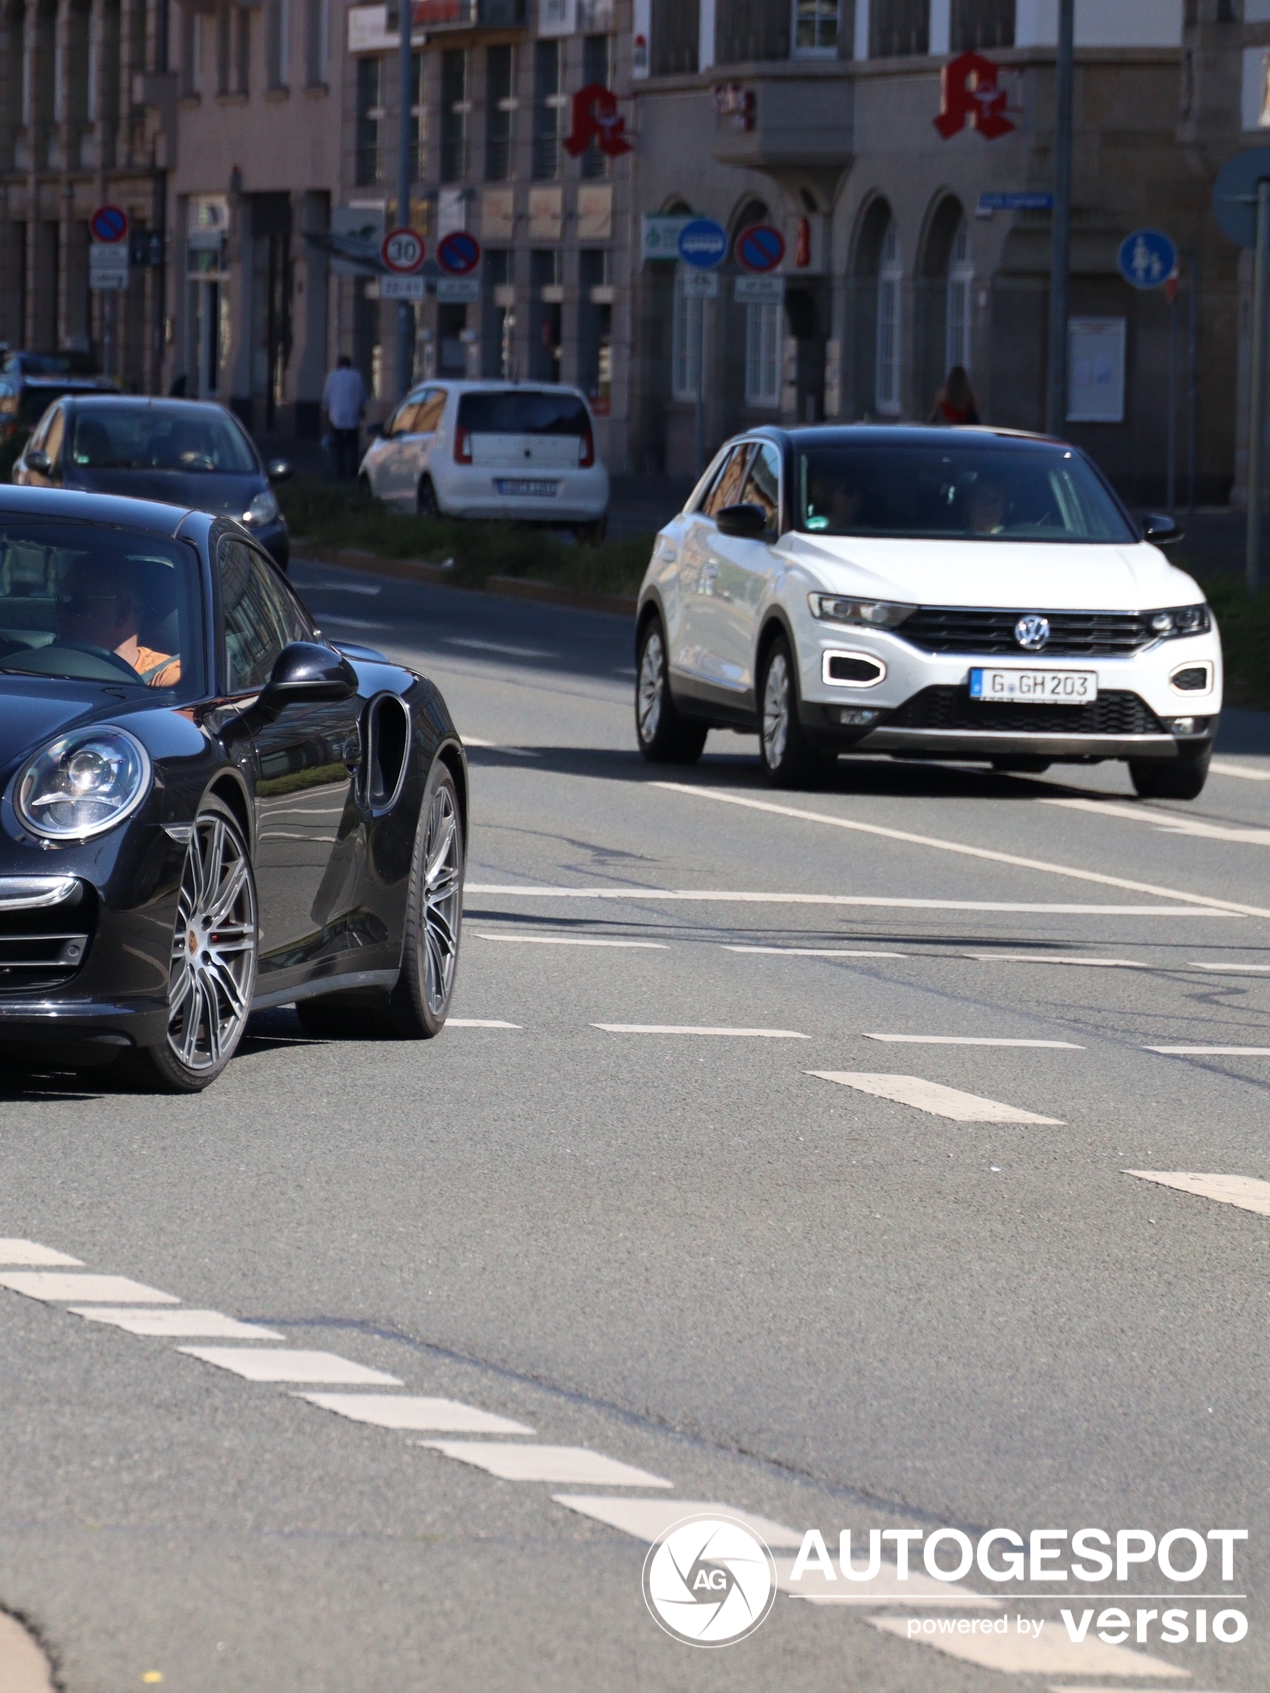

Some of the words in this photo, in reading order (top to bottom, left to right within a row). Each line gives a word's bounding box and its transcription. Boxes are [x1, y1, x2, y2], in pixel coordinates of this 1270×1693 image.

[391, 241, 417, 261] 30
[992, 674, 1005, 693] G
[1019, 675, 1046, 695] GH
[1051, 676, 1089, 696] 203
